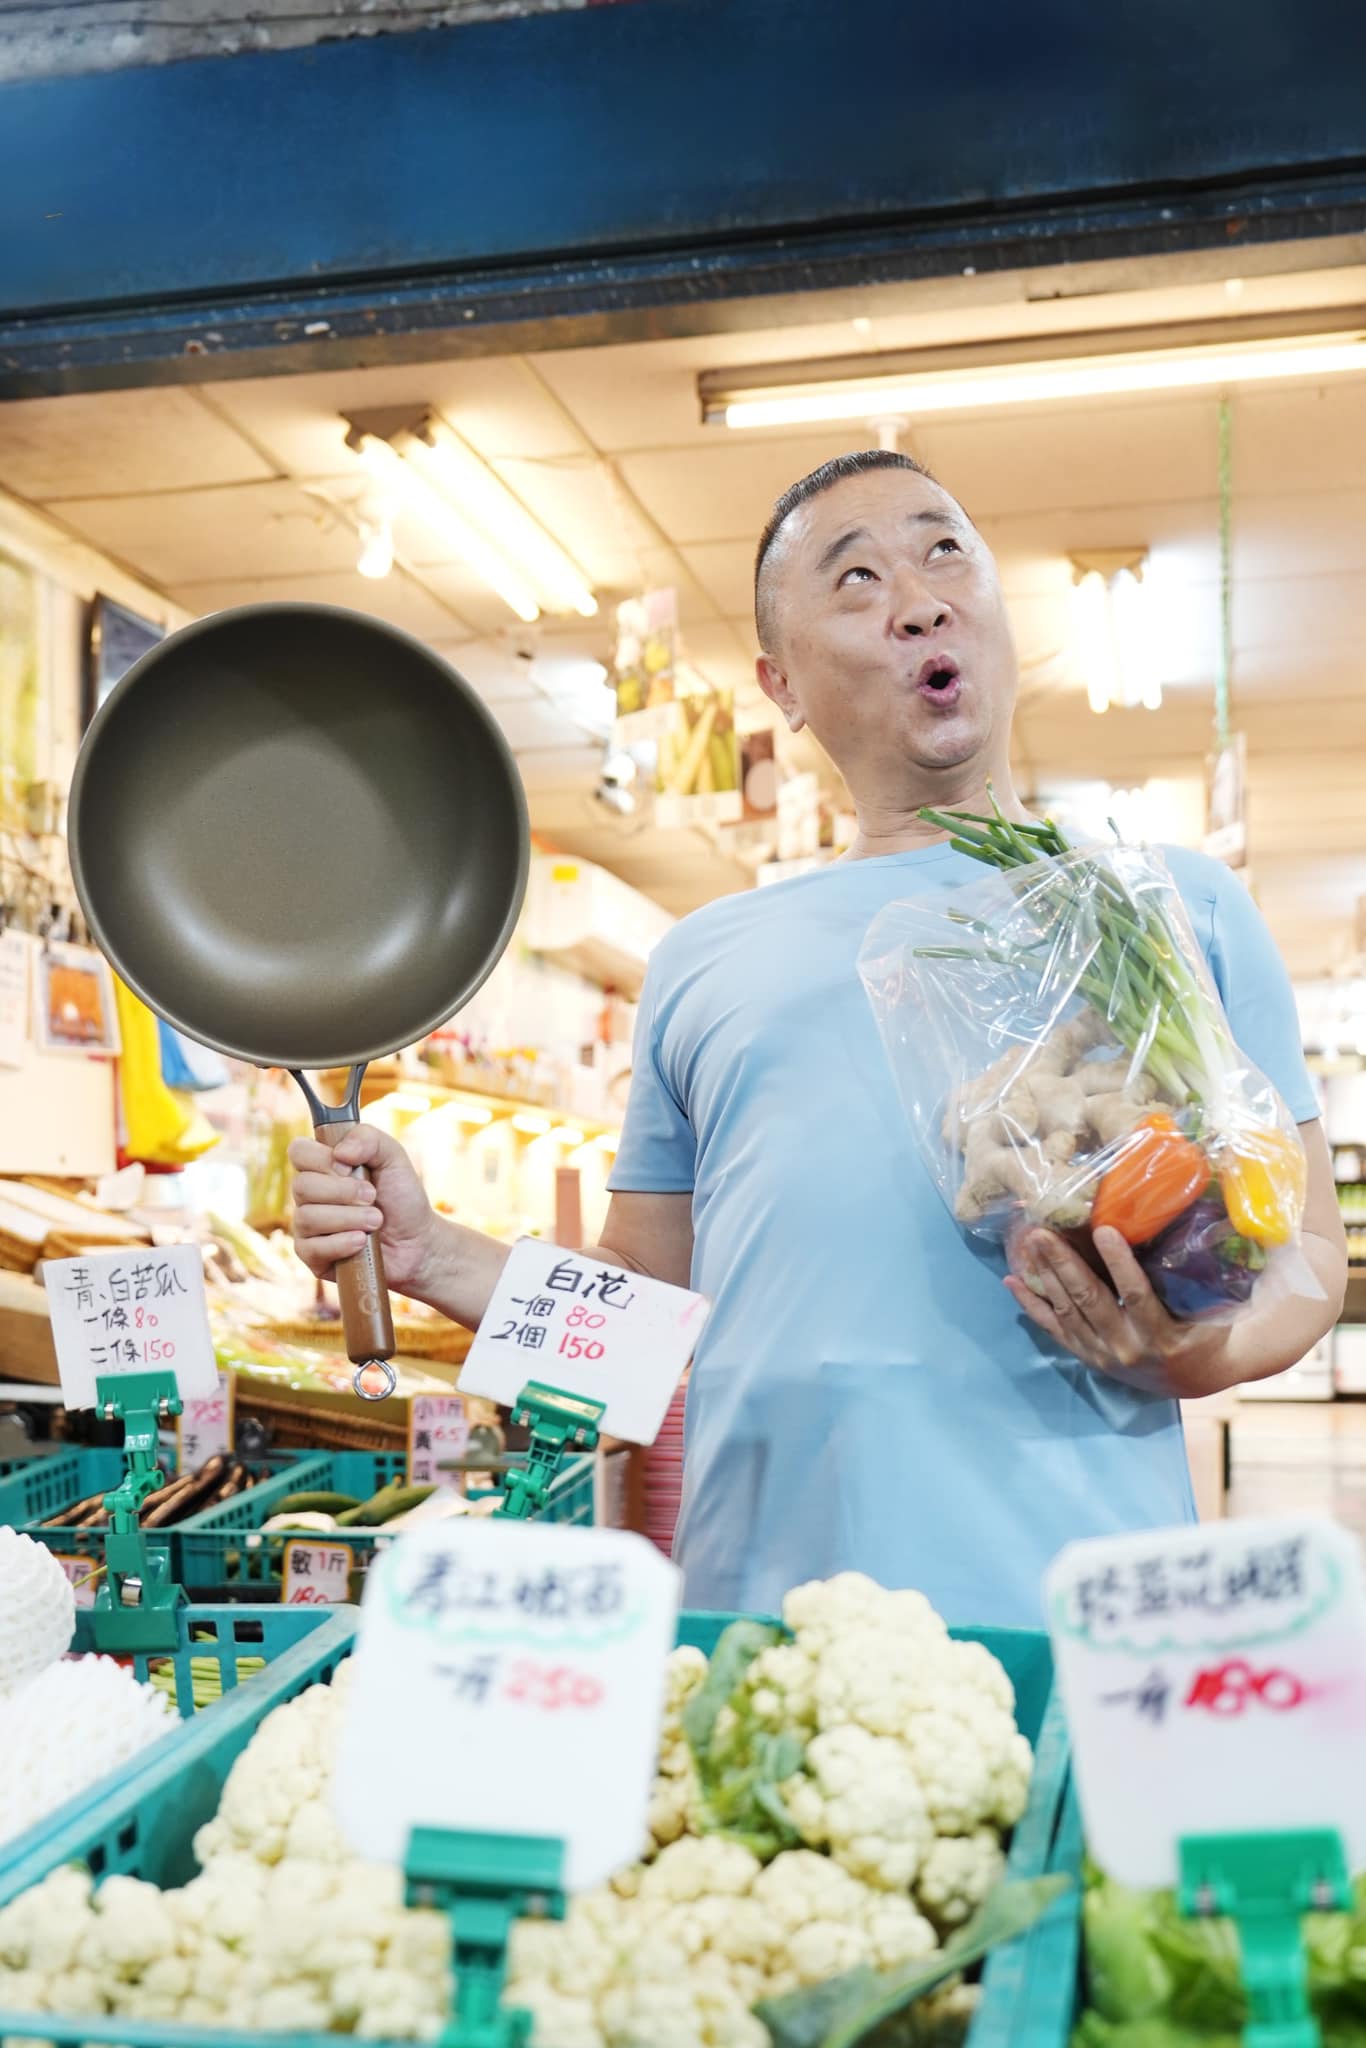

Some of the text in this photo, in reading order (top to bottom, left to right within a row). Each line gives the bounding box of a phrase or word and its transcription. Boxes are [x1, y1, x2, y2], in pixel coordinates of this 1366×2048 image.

[545, 1259, 635, 1310] 白花
[511, 1294, 606, 1329] 一個 80
[489, 1320, 605, 1360] 2個 150
[1183, 1656, 1305, 1718] 180
